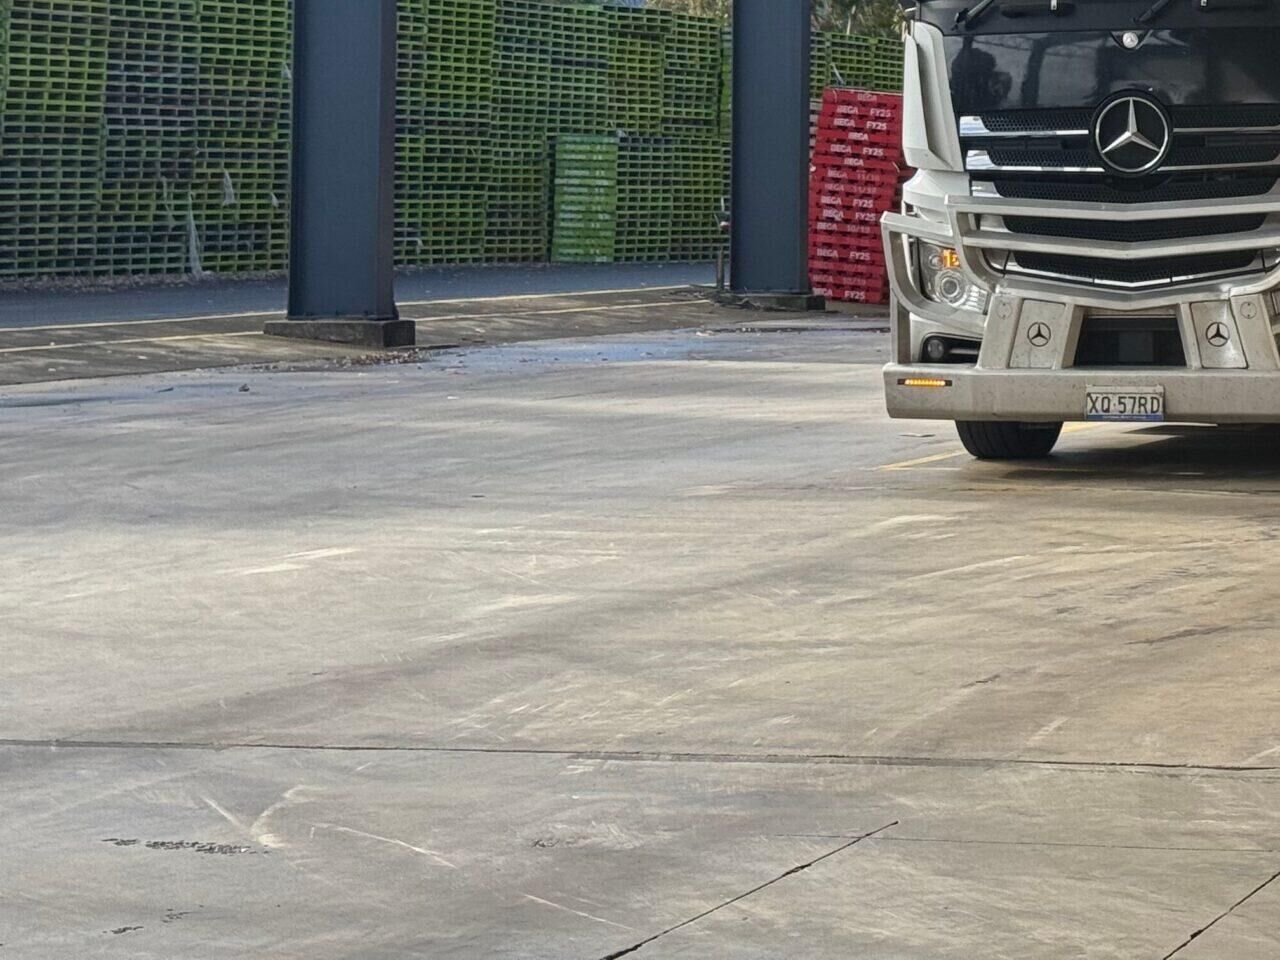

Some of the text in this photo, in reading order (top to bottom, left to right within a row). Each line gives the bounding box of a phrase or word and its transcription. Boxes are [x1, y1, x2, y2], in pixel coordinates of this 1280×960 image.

[836, 104, 891, 118] BEGA FY25
[834, 118, 888, 131] BEGA FY25
[830, 144, 884, 156] BEGA FY25
[821, 196, 874, 208] BEGA FY25
[855, 212, 876, 222] FY25
[817, 248, 871, 261] BEGA FY25
[844, 290, 865, 300] FY25
